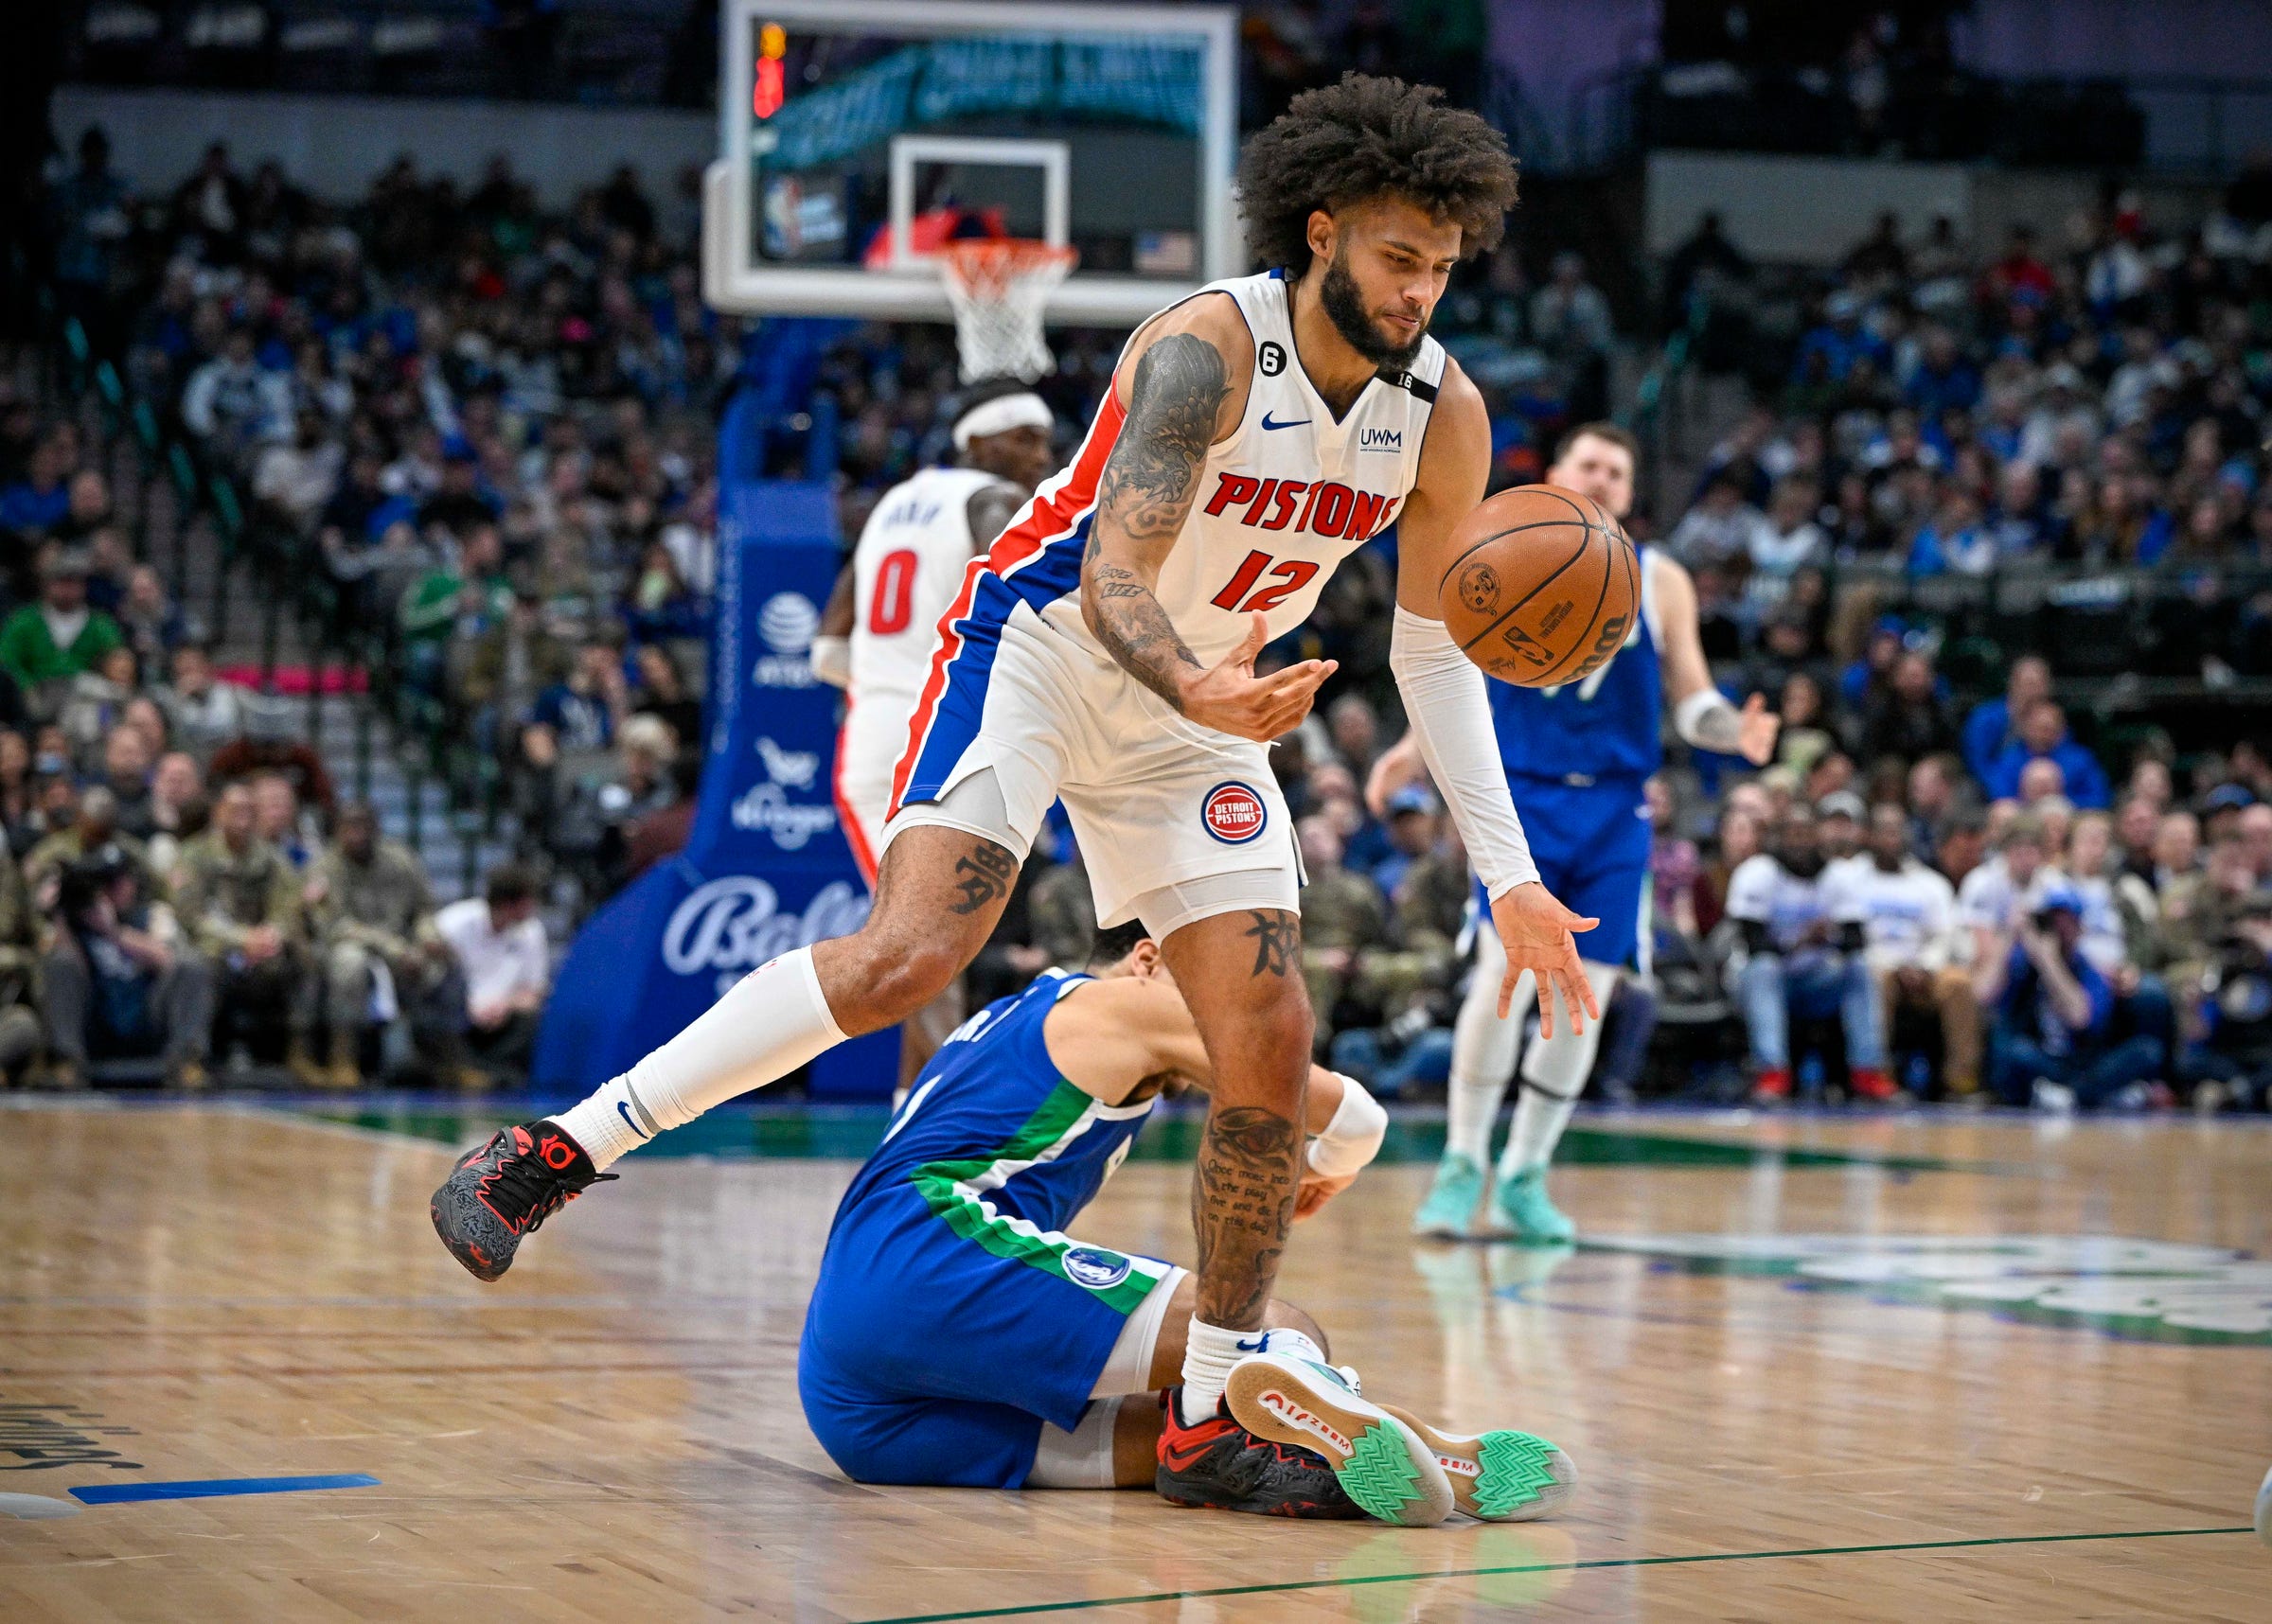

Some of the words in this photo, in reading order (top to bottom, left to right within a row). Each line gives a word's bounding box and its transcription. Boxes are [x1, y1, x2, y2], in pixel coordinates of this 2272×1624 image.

[1262, 346, 1279, 375] 6
[1397, 373, 1413, 389] 16
[1360, 429, 1402, 447] UWM
[1210, 549, 1321, 613] 12
[871, 549, 918, 635] 0
[1214, 803, 1254, 814] DETROIT
[1215, 812, 1256, 825] PISTONS
[1433, 1455, 1473, 1472] OOM
